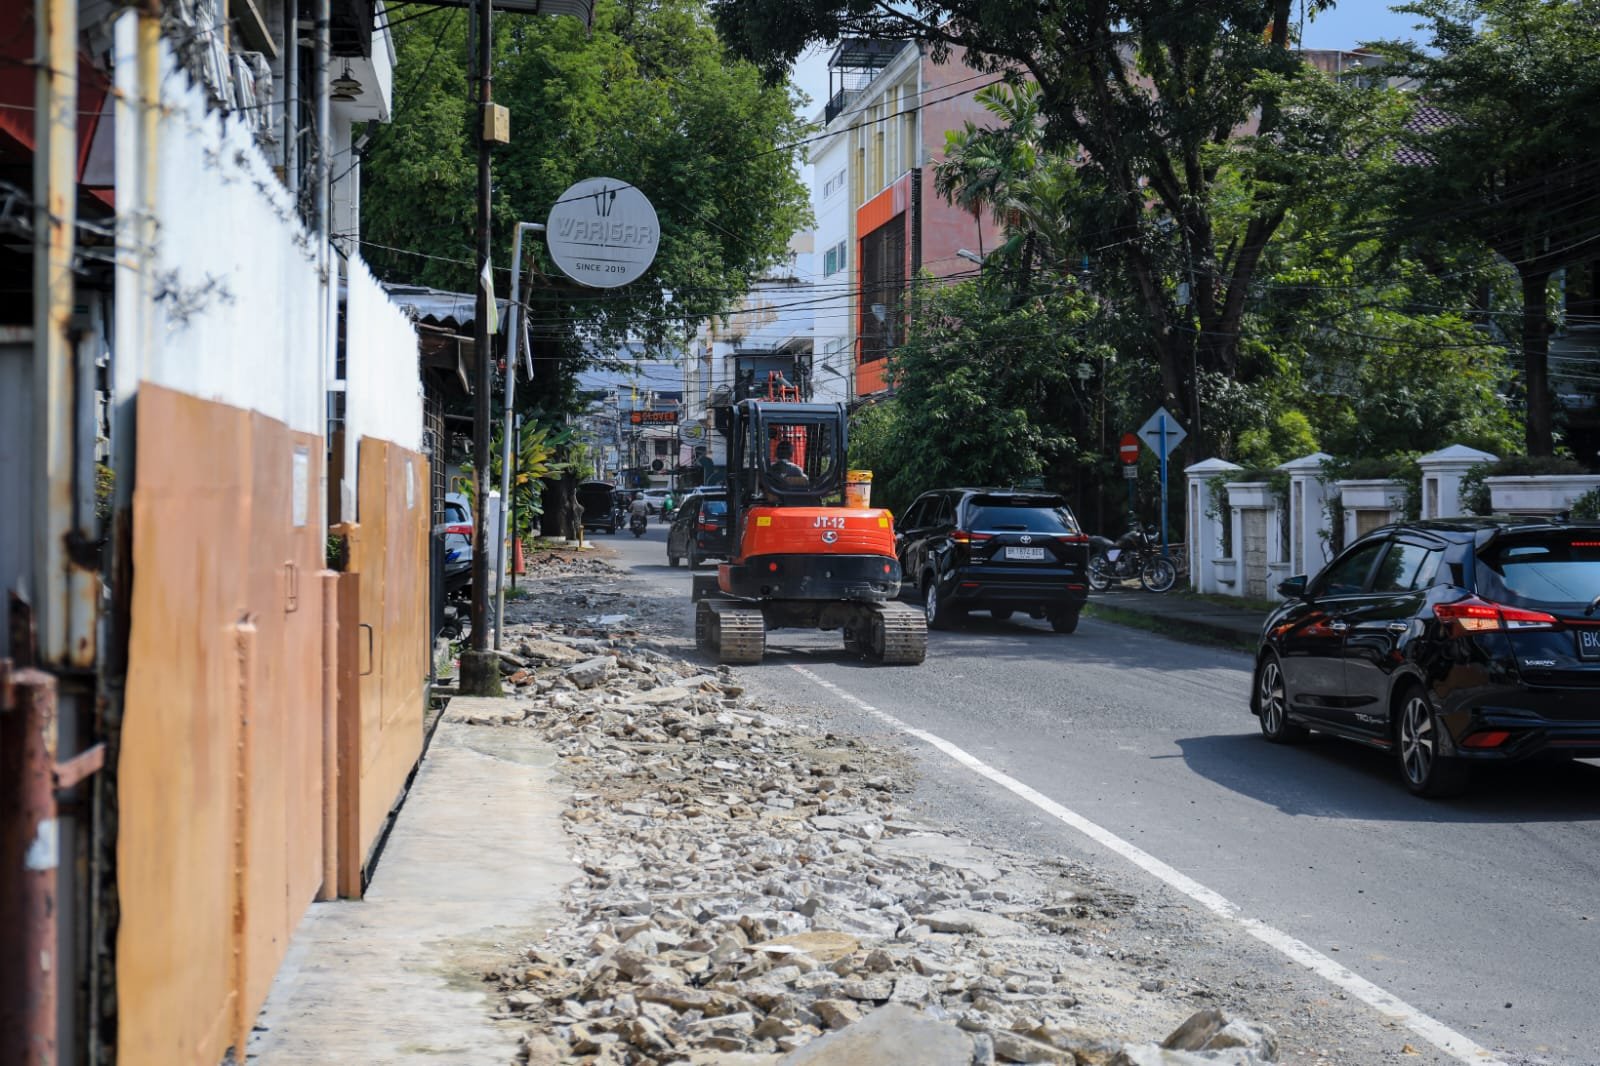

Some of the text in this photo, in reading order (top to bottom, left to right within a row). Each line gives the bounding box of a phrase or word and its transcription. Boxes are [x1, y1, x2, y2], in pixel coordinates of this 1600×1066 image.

[575, 262, 626, 274] SINCE 2019
[813, 516, 845, 529] JT-12
[1582, 631, 1600, 647] BK
